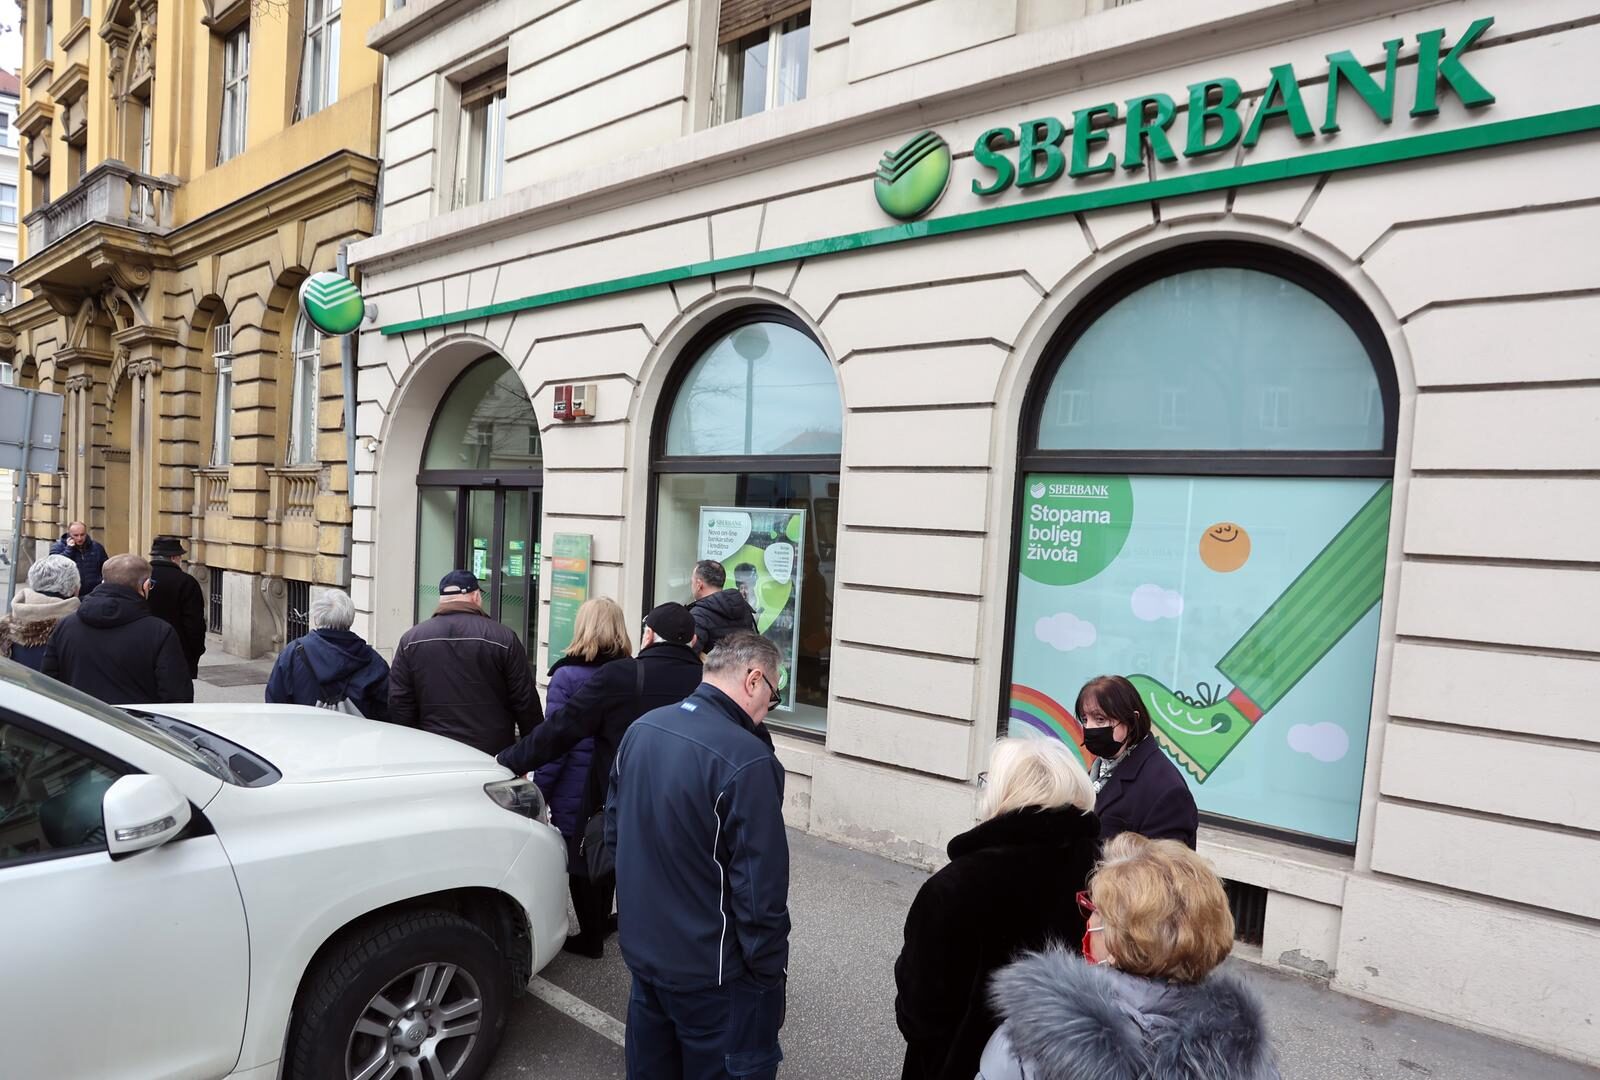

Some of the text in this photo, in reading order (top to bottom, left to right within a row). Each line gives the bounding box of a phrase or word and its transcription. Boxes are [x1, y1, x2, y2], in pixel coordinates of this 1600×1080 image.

[971, 17, 1495, 195] SBERBANK
[1049, 483, 1109, 496] SBERBANK
[1030, 504, 1111, 526] Stopama
[1029, 524, 1082, 547] boljeg
[1027, 543, 1078, 562] života
